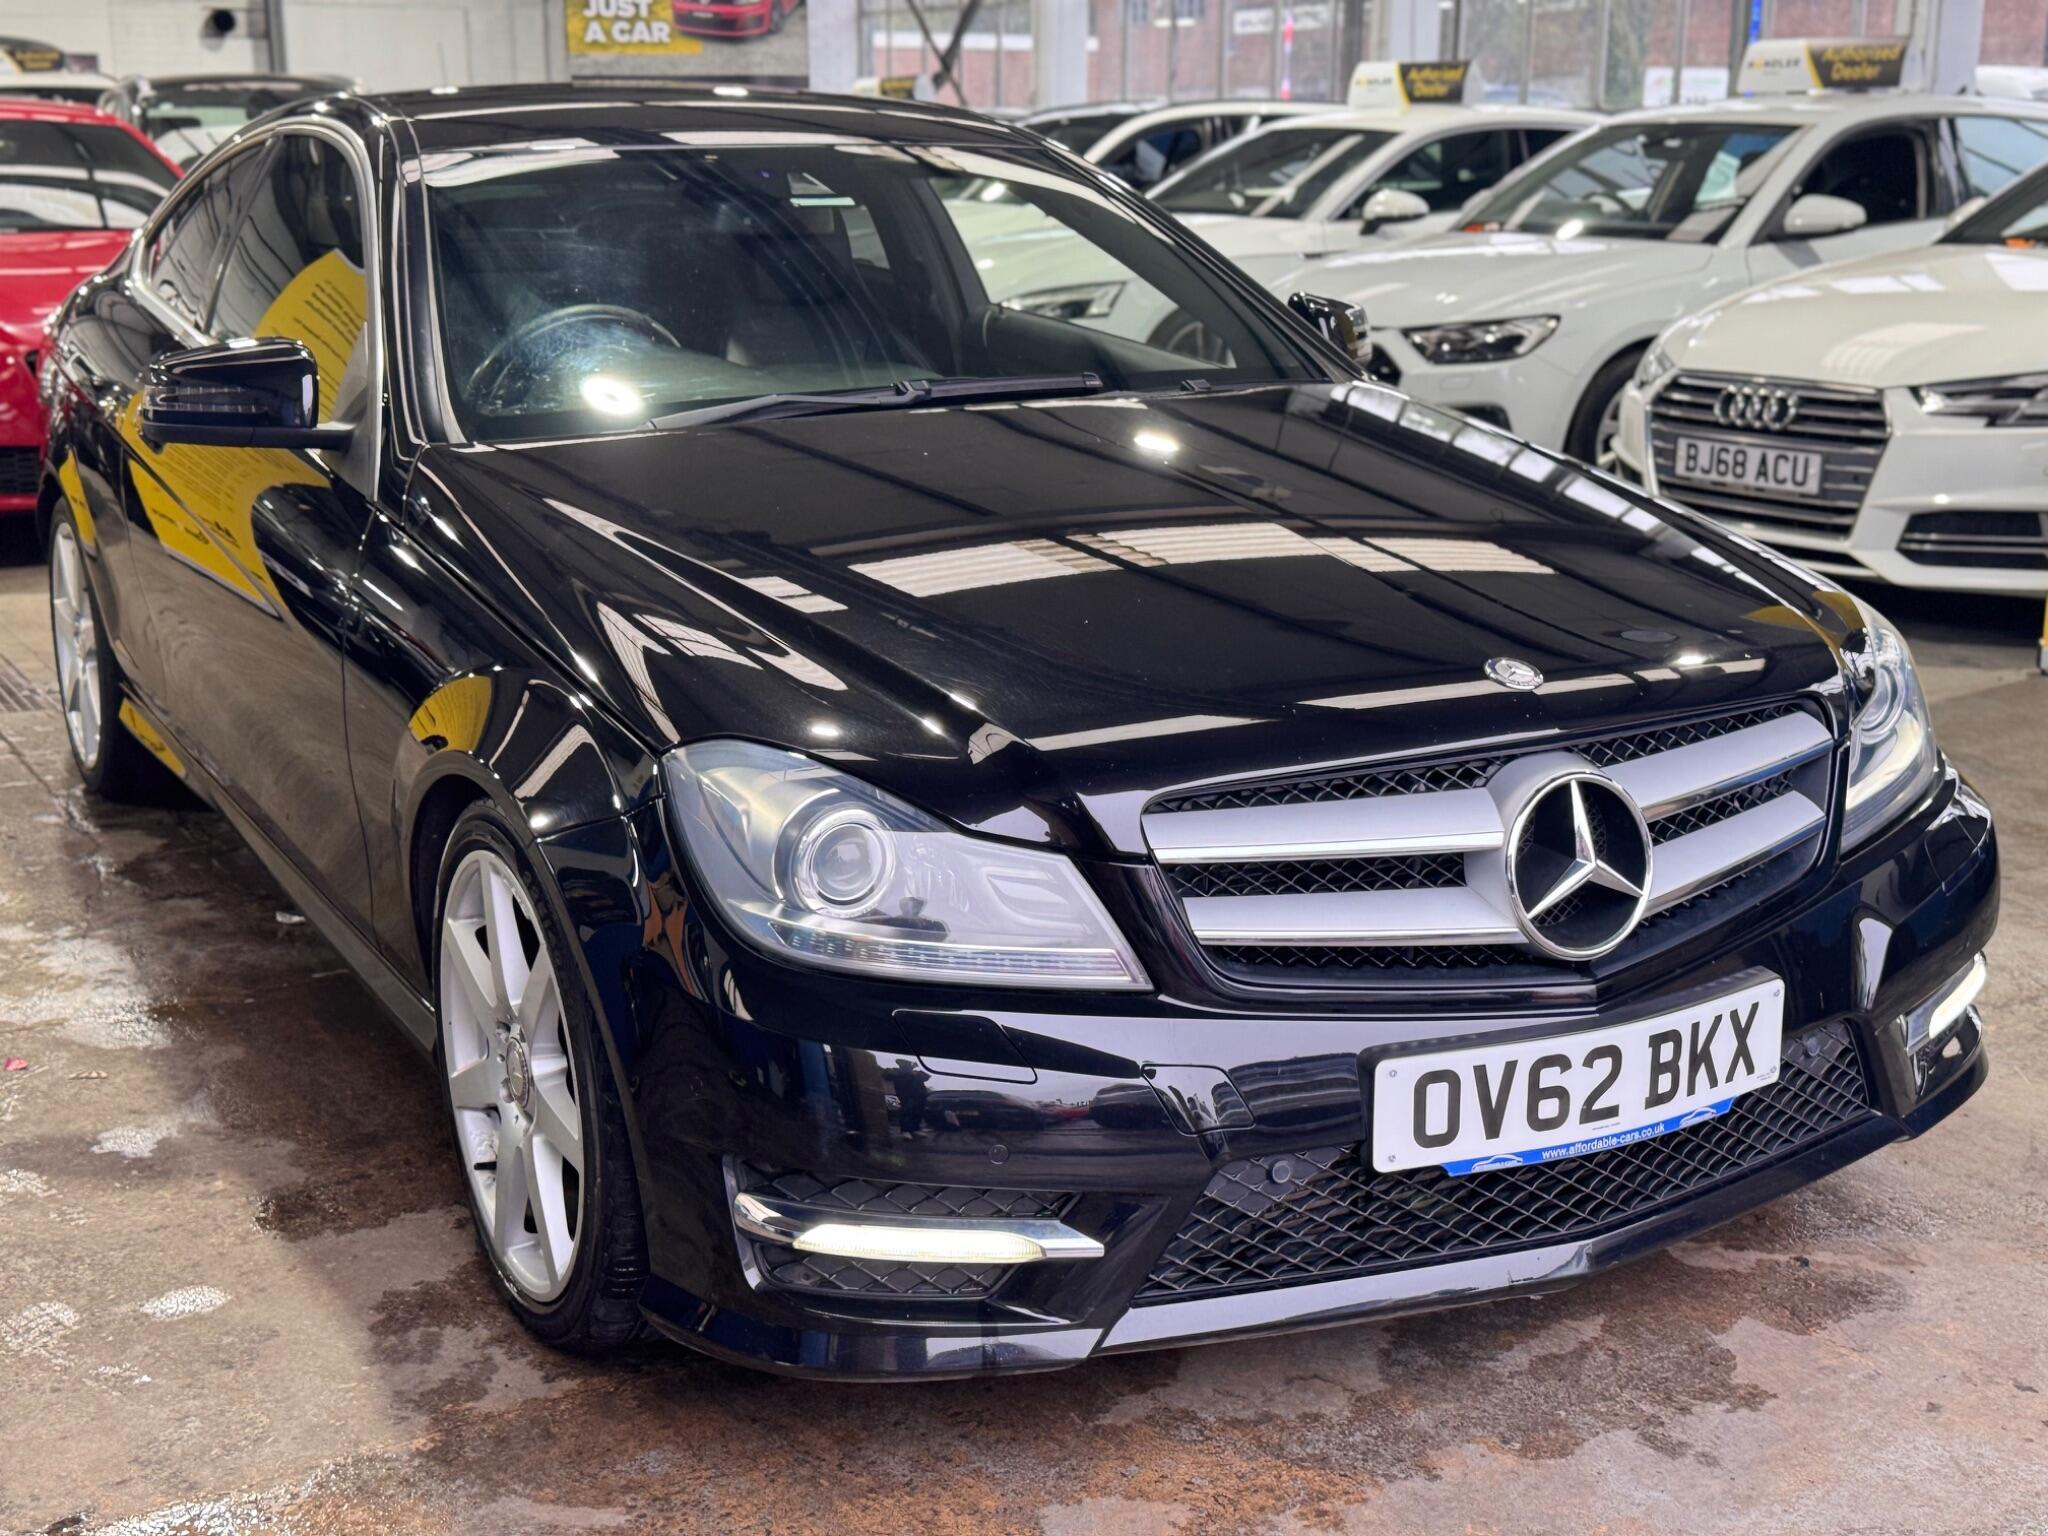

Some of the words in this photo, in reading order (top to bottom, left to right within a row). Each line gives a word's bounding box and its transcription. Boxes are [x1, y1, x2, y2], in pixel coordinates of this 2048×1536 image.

[582, 0, 653, 18] JUST
[583, 20, 608, 43] A
[611, 20, 671, 43] CAR
[1684, 441, 1748, 479] BJ68
[1755, 451, 1809, 487] ACU
[1412, 1044, 1624, 1149] OV62
[1644, 1000, 1760, 1110] BKX
[1541, 1122, 1665, 1161] www.affordable-cars.co.uk
